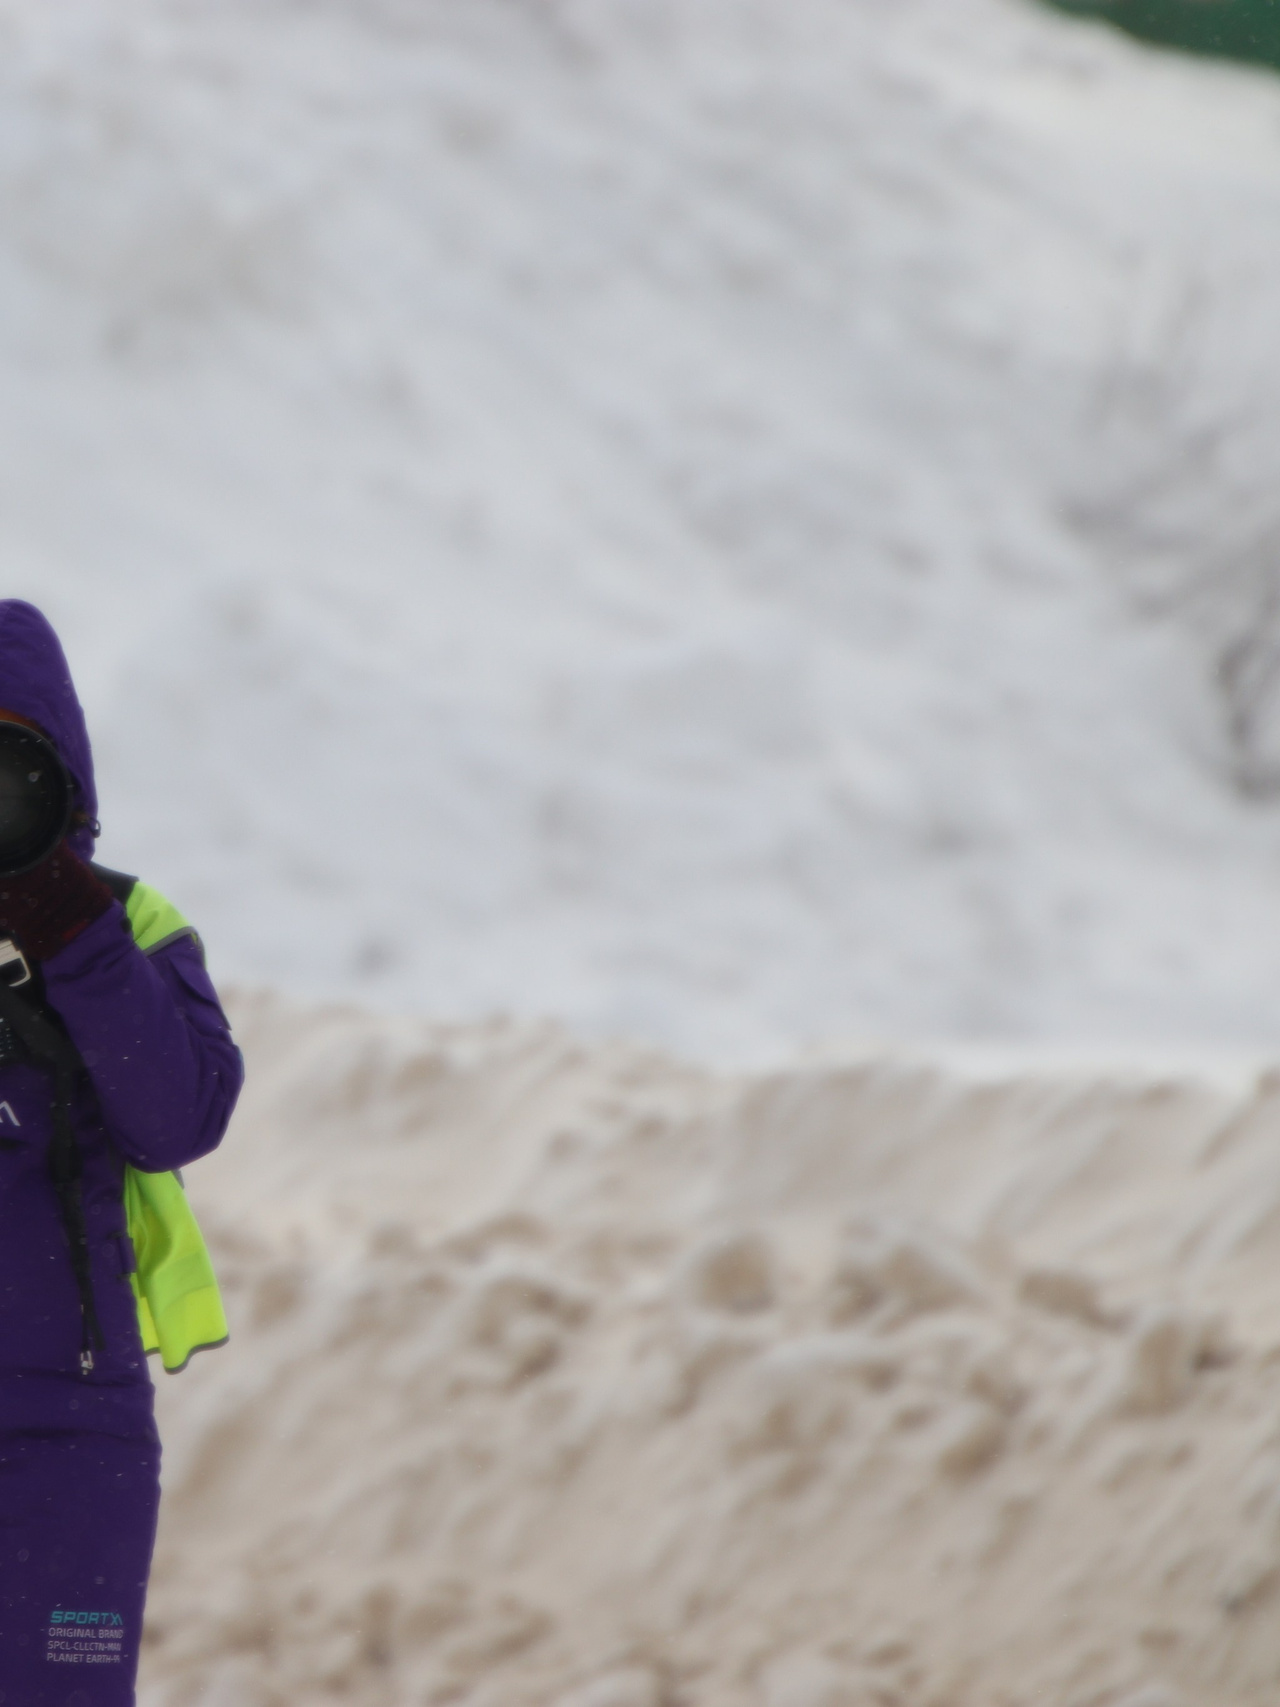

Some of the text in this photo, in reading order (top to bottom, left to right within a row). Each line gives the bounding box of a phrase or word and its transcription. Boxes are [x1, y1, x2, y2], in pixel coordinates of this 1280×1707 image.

[48, 1627, 124, 1639] ORIGINAL BRAND
[46, 1652, 85, 1663] PLANET
